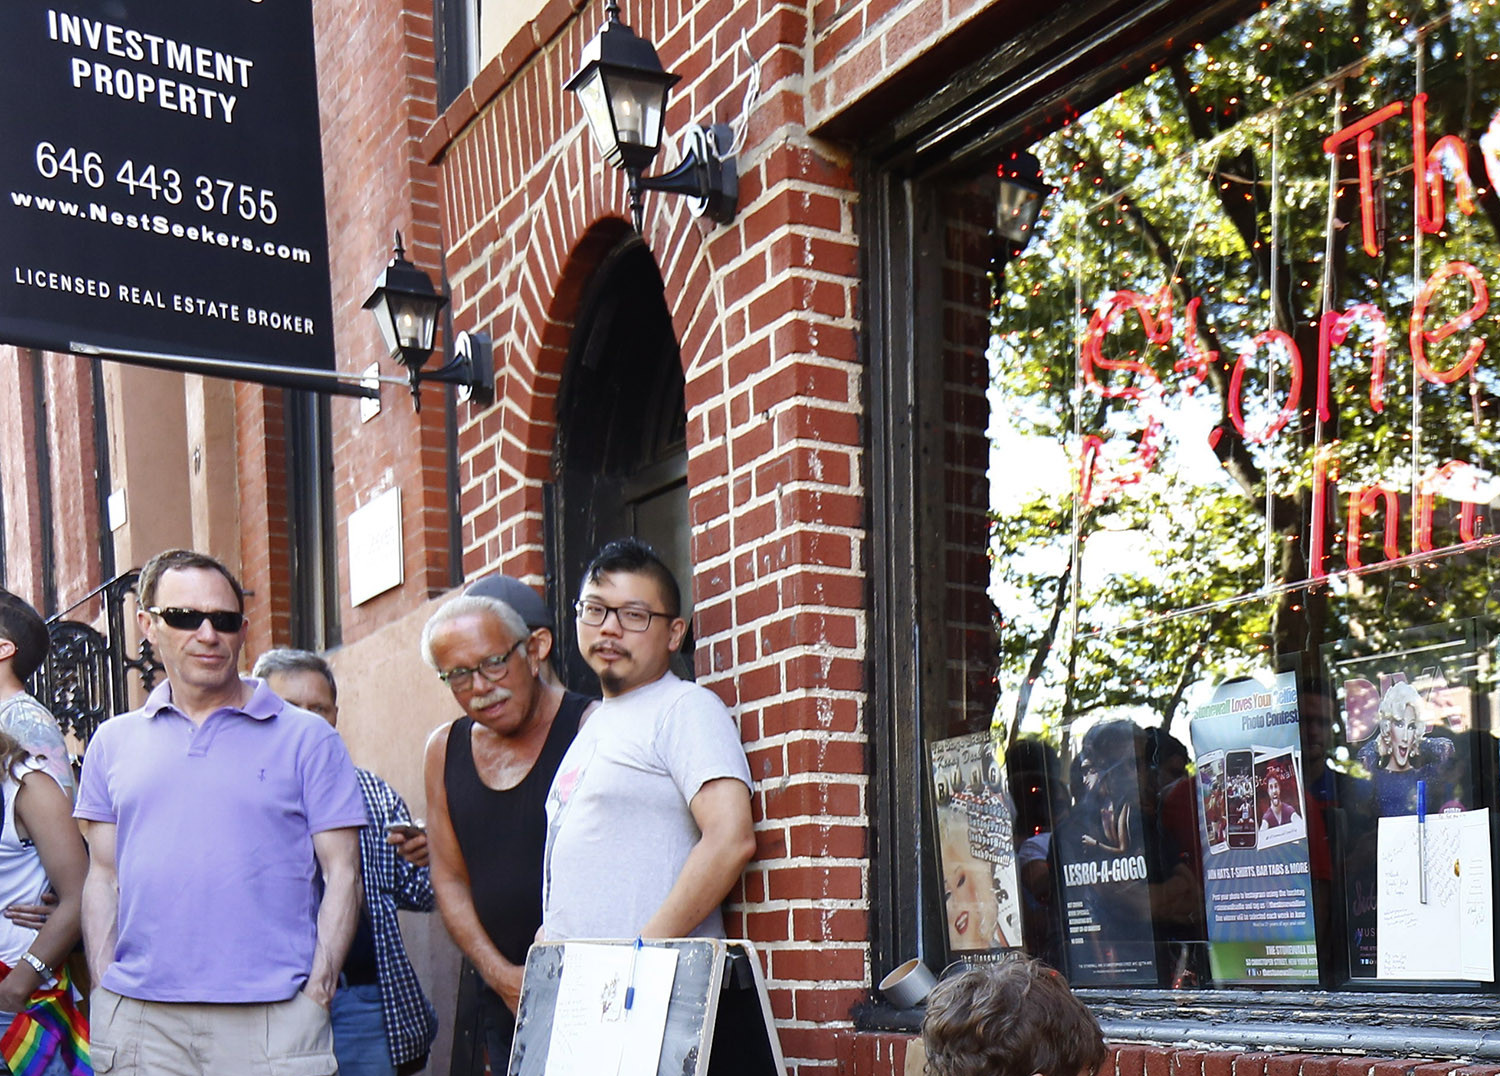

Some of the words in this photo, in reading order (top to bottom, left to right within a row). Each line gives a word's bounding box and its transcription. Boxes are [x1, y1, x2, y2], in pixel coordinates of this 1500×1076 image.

[48, 10, 253, 88] INVESTMENT
[71, 57, 237, 124] PROPERTY
[36, 141, 105, 189] 646
[116, 160, 182, 204] 443
[196, 175, 278, 225] 3755
[11, 191, 312, 264] www.NestSeekers.com
[15, 267, 111, 298] LICENSED
[119, 285, 166, 309] REAL
[174, 294, 240, 322] ESTATE
[247, 308, 314, 335] BROKER
[1310, 445, 1482, 579] Inn
[1231, 695, 1253, 713] Loves
[1254, 692, 1271, 708] Your
[1242, 713, 1265, 731] Photo
[1266, 709, 1300, 727] Contest
[1063, 855, 1148, 887] LESBO-A-GOGO
[1256, 865, 1268, 876] BAR
[1269, 864, 1284, 875] TABS
[1290, 862, 1309, 874] MORE
[1357, 927, 1377, 938] MUS
